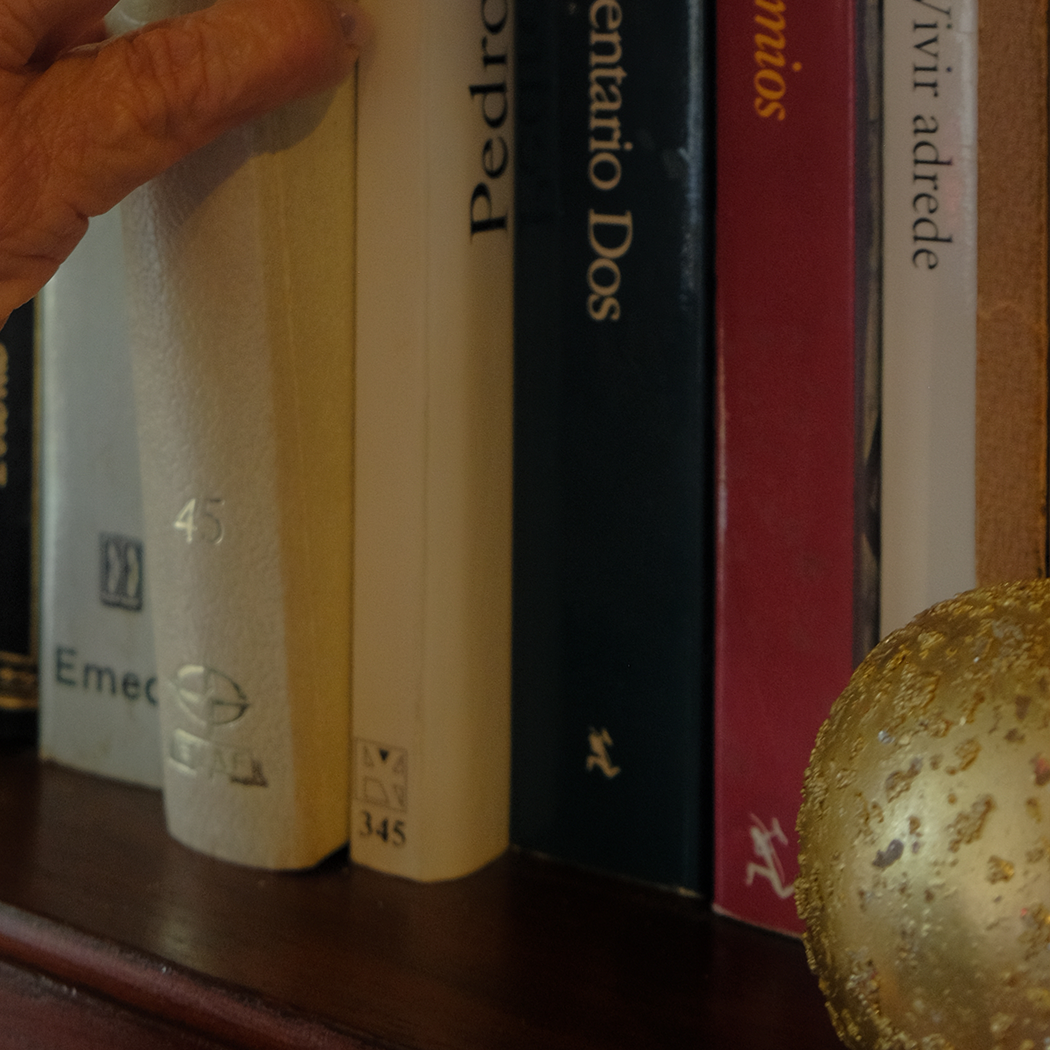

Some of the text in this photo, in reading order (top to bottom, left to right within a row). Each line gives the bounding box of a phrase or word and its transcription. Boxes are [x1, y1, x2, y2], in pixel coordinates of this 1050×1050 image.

[912, 113, 953, 272] adrede
[587, 209, 634, 322] Dos
[174, 497, 225, 545] 45
[358, 810, 407, 847] 345
